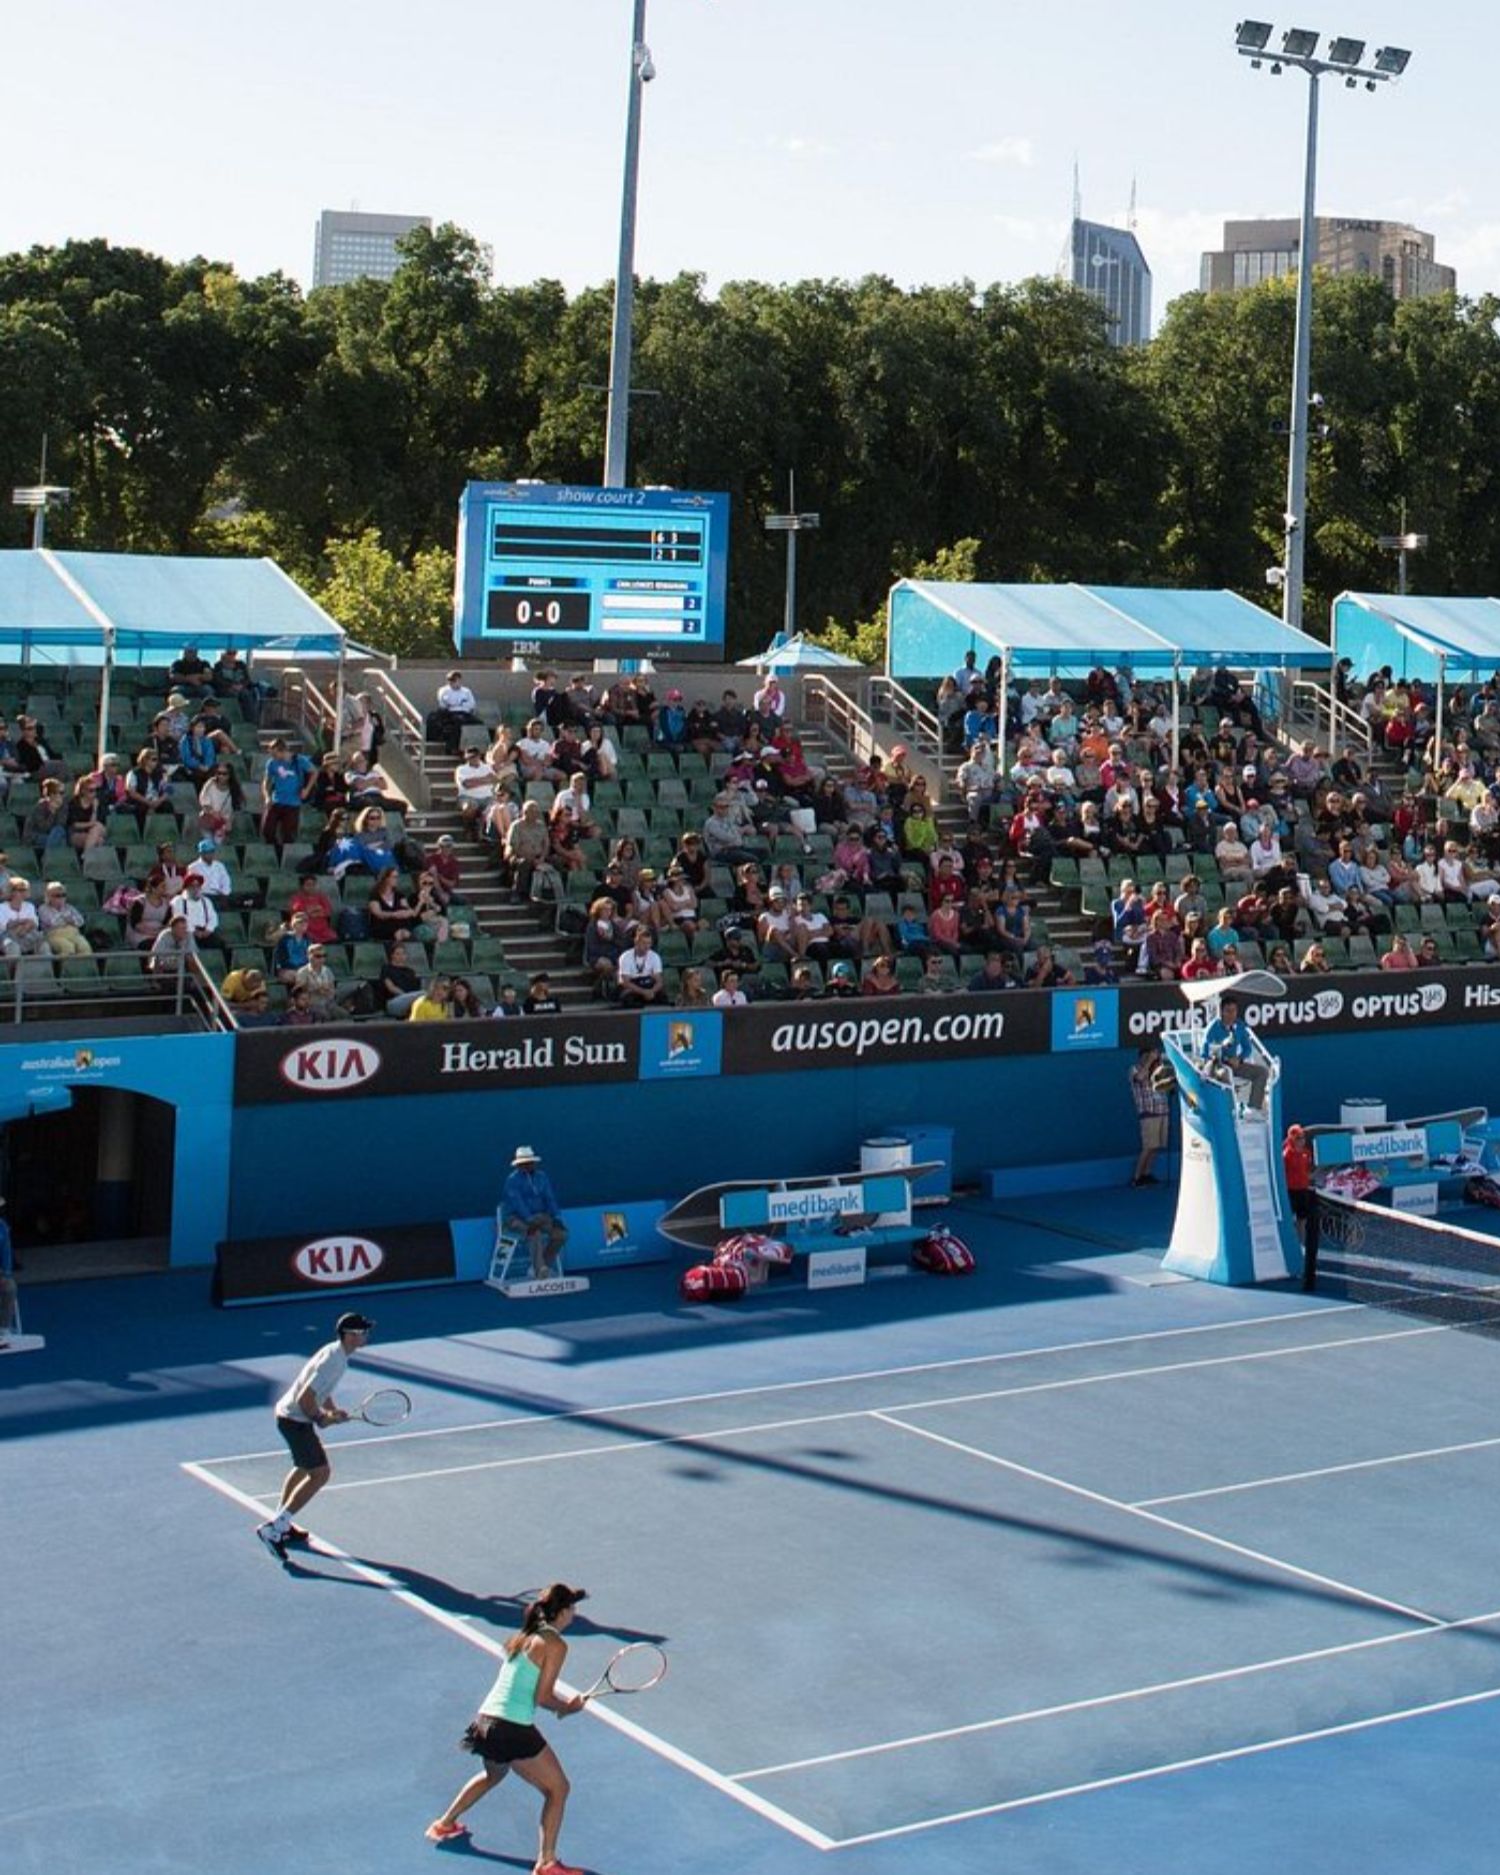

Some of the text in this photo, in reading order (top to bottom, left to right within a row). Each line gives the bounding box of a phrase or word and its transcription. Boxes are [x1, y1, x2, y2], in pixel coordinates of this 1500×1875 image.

[556, 488, 646, 505] show court 2
[512, 640, 541, 655] IBM
[1245, 1000, 1317, 1027] OPTUS
[1352, 993, 1420, 1018] OPTUS
[771, 1011, 1004, 1055] ausopen.com
[1128, 1008, 1204, 1035] OPTUS
[297, 1049, 366, 1080] KIA
[440, 1038, 553, 1073] Herald
[564, 1036, 627, 1066] Sun
[1354, 1134, 1424, 1157] medibank
[771, 1193, 860, 1219] medibank
[307, 1245, 372, 1275] KIA
